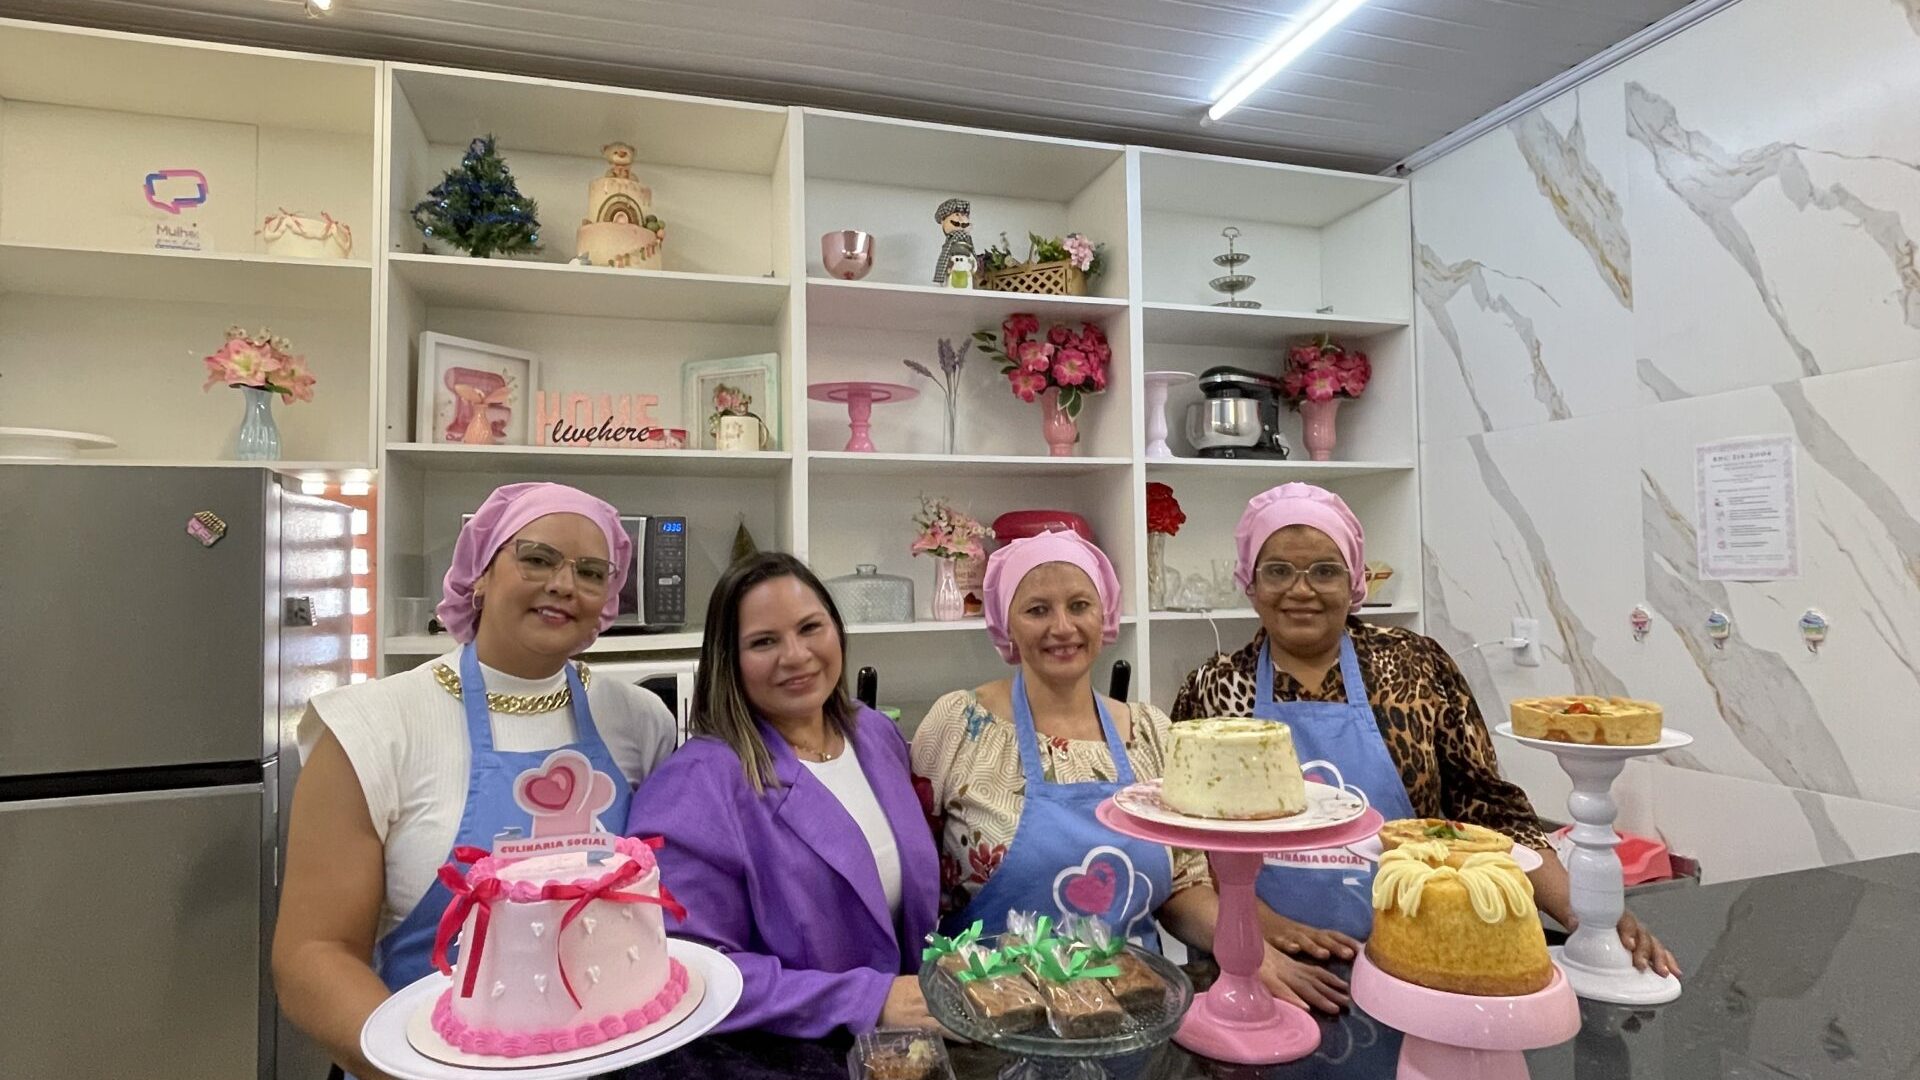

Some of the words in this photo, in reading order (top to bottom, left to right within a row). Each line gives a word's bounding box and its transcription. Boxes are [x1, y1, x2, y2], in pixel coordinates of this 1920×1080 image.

[536, 390, 659, 448] HOME
[567, 838, 607, 847] SOCIAL
[1321, 854, 1365, 866] SOCIAL
